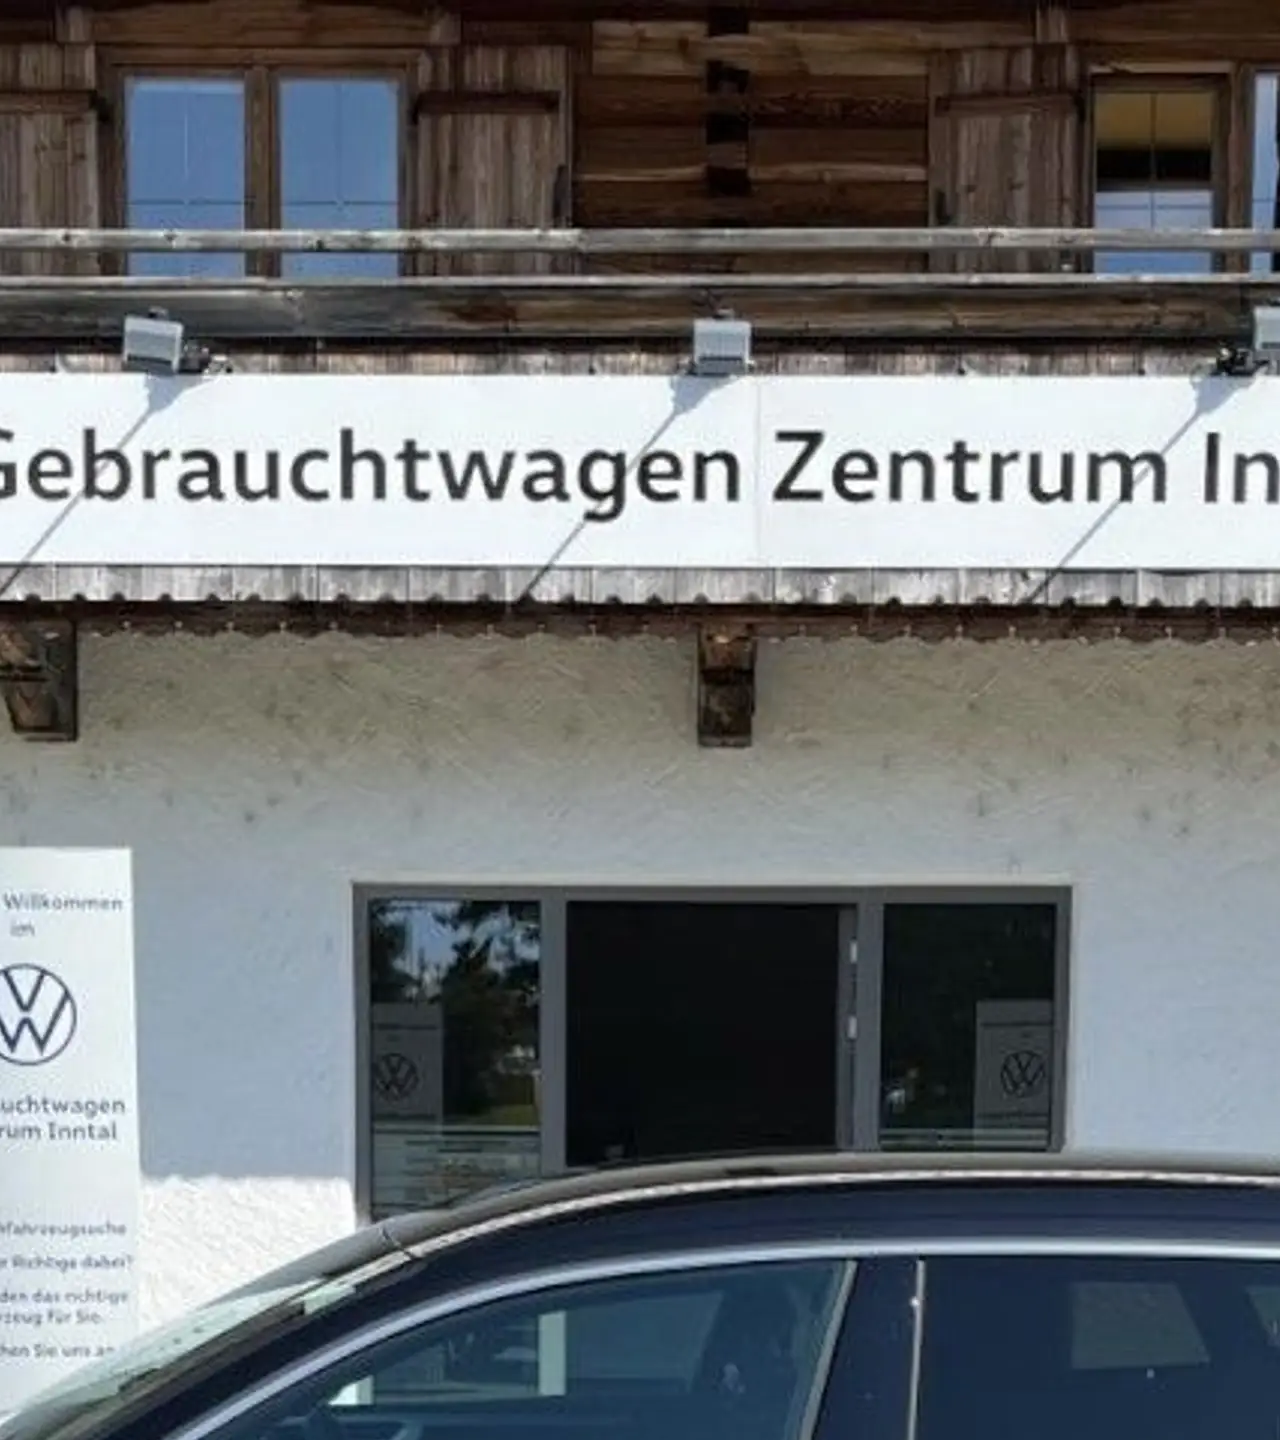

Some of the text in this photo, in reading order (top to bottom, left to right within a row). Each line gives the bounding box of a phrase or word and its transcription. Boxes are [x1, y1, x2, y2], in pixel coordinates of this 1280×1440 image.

[774, 430, 1166, 503] Zentrum
[5, 892, 122, 910] Willkommen
[10, 922, 36, 937] im
[48, 1120, 117, 1140] Inntal
[31, 1287, 61, 1302] das
